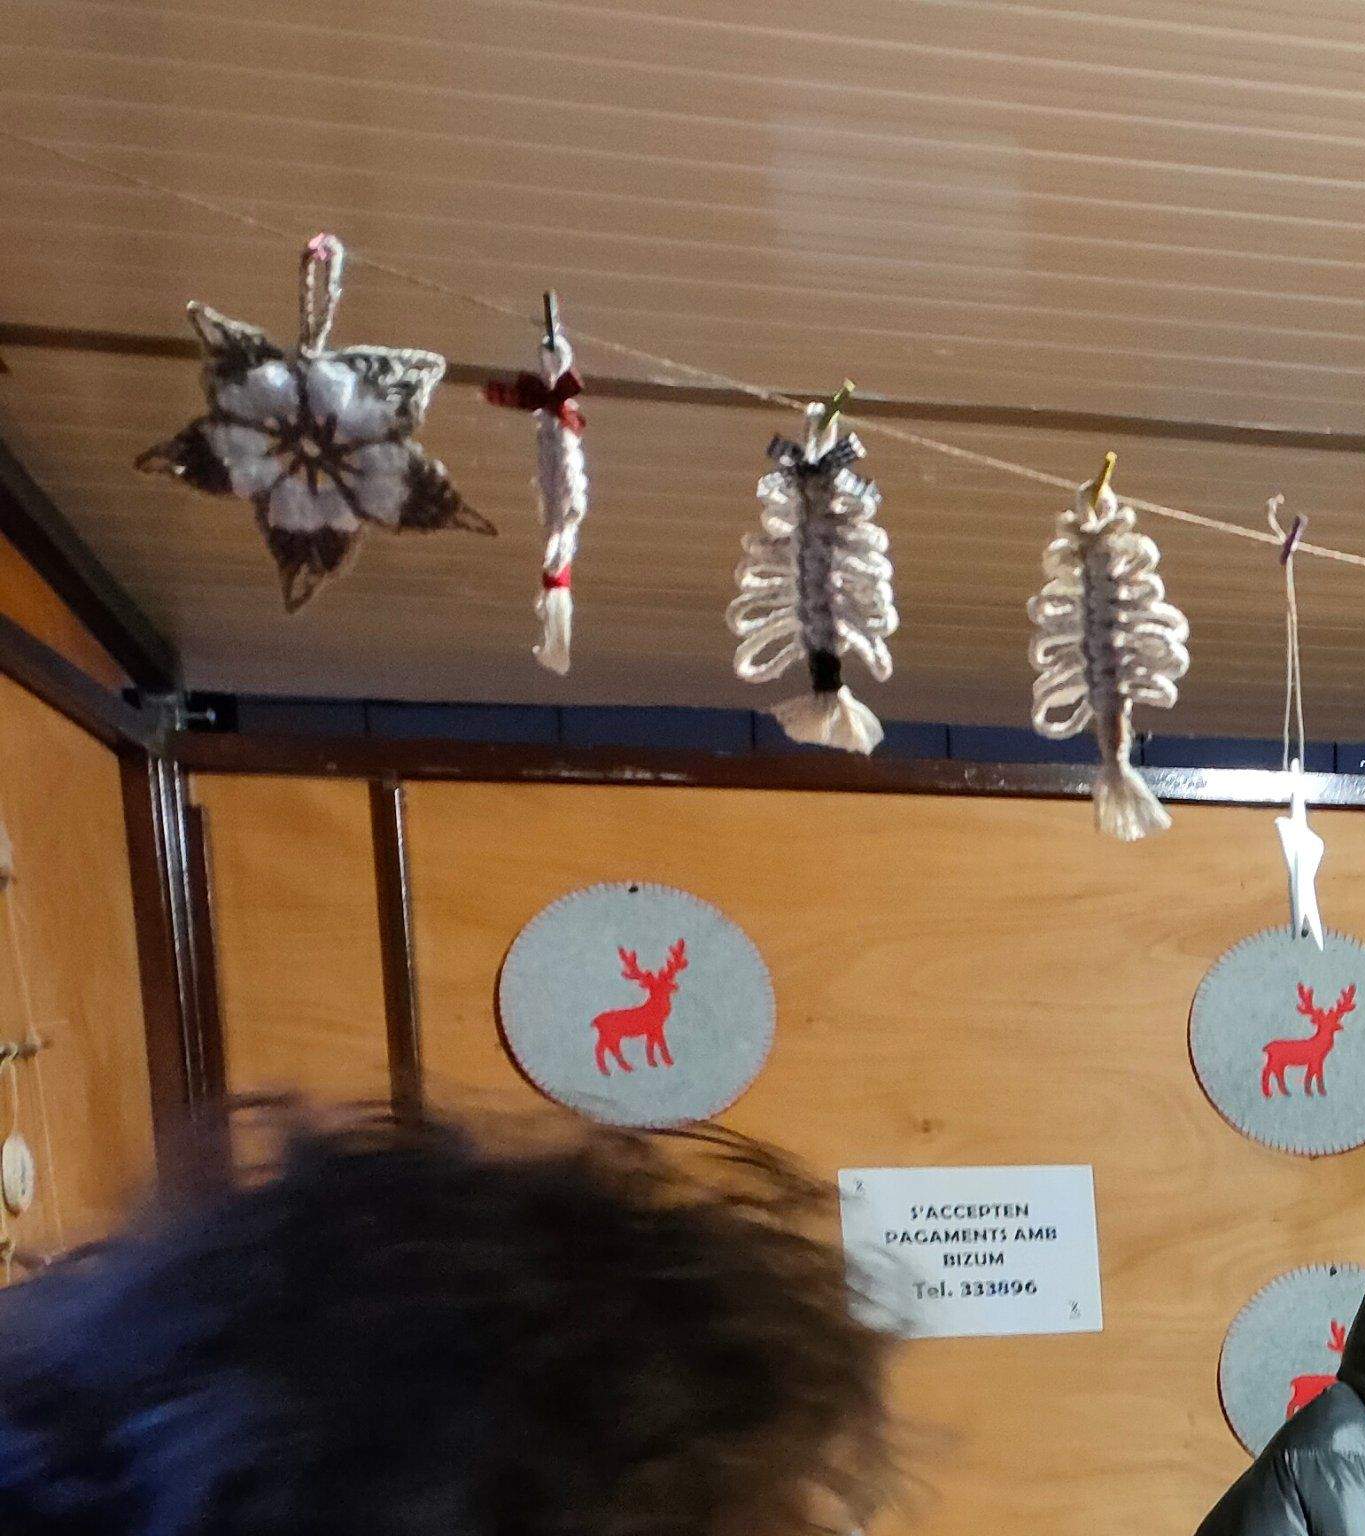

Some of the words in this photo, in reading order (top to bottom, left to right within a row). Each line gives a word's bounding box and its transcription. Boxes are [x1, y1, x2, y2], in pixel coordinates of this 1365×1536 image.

[910, 1203, 1029, 1220] S'ACCEPTEN
[885, 1227, 1007, 1245] PAGAMENTS
[1013, 1225, 1058, 1242] AMB
[943, 1252, 1005, 1267] BIZUM
[912, 1281, 953, 1299] Tel.
